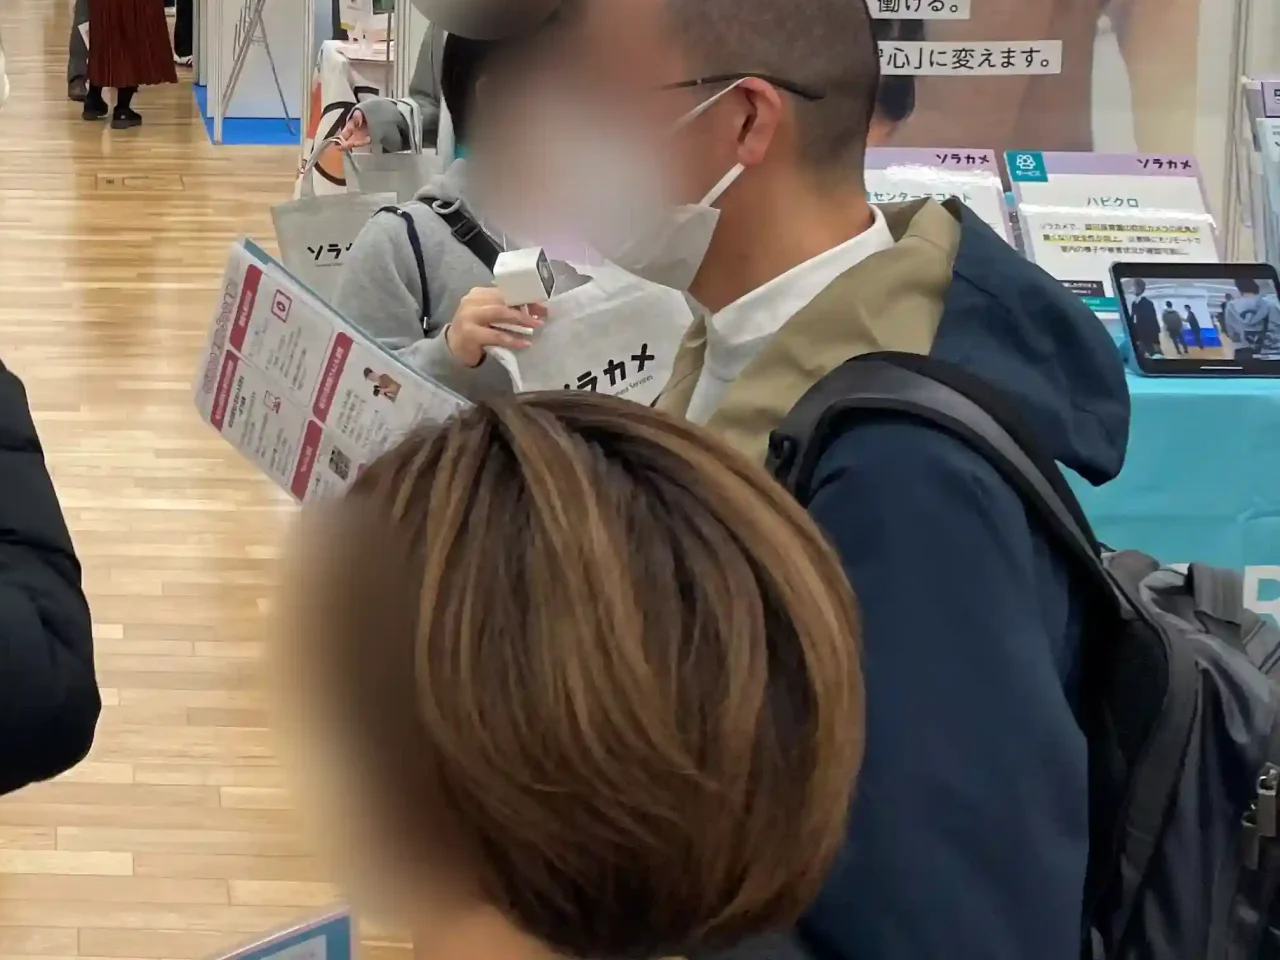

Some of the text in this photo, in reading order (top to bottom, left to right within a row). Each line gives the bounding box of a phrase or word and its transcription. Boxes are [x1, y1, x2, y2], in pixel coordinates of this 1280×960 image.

[877, 46, 1051, 70] 心」に変えます。
[935, 153, 991, 165] ソラカメ
[1136, 157, 1194, 171] ソラカメ
[563, 343, 656, 393] ラカメ
